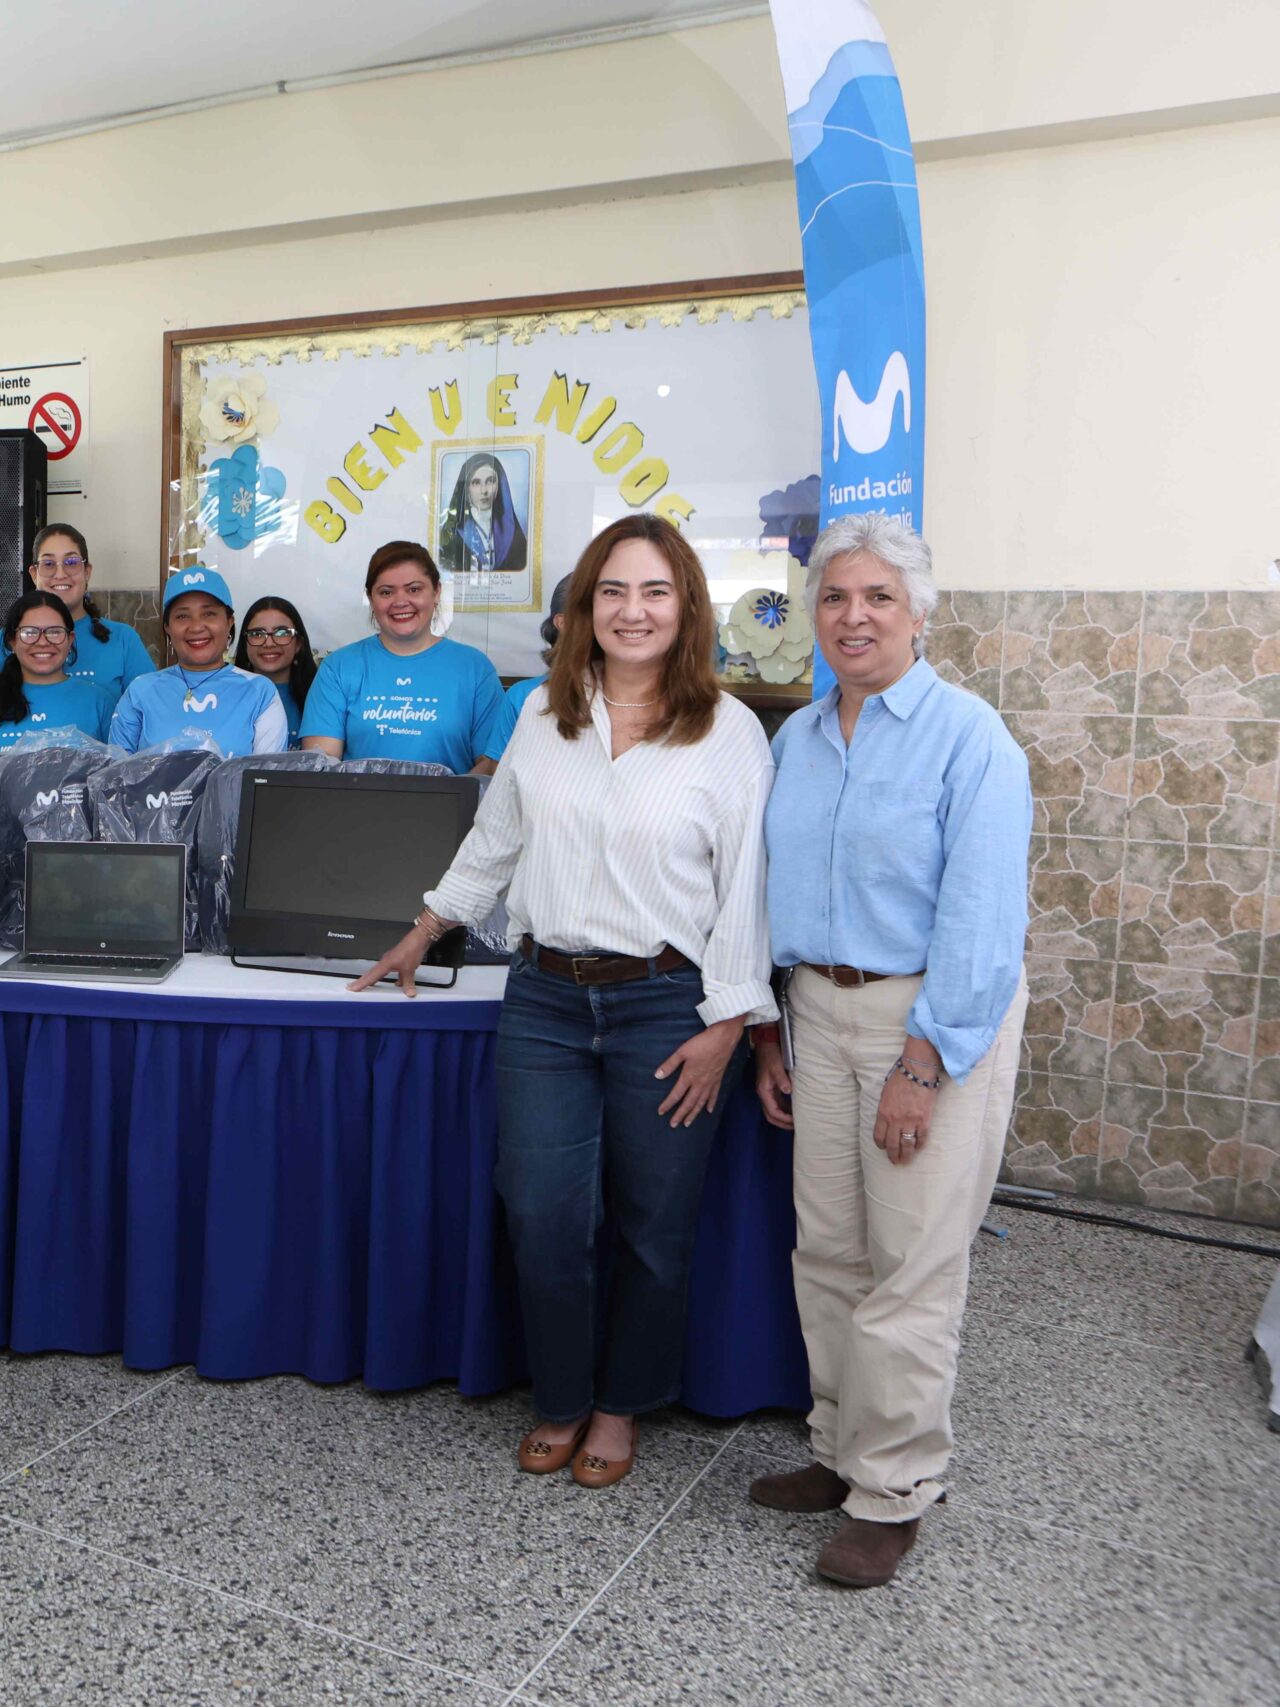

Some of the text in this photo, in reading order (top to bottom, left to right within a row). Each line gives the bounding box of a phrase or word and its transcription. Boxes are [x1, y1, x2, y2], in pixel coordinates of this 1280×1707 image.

[829, 470, 912, 507] Fundación
[363, 701, 438, 723] voluntarios
[389, 727, 422, 736] Telefónica
[327, 931, 355, 939] lenovo
